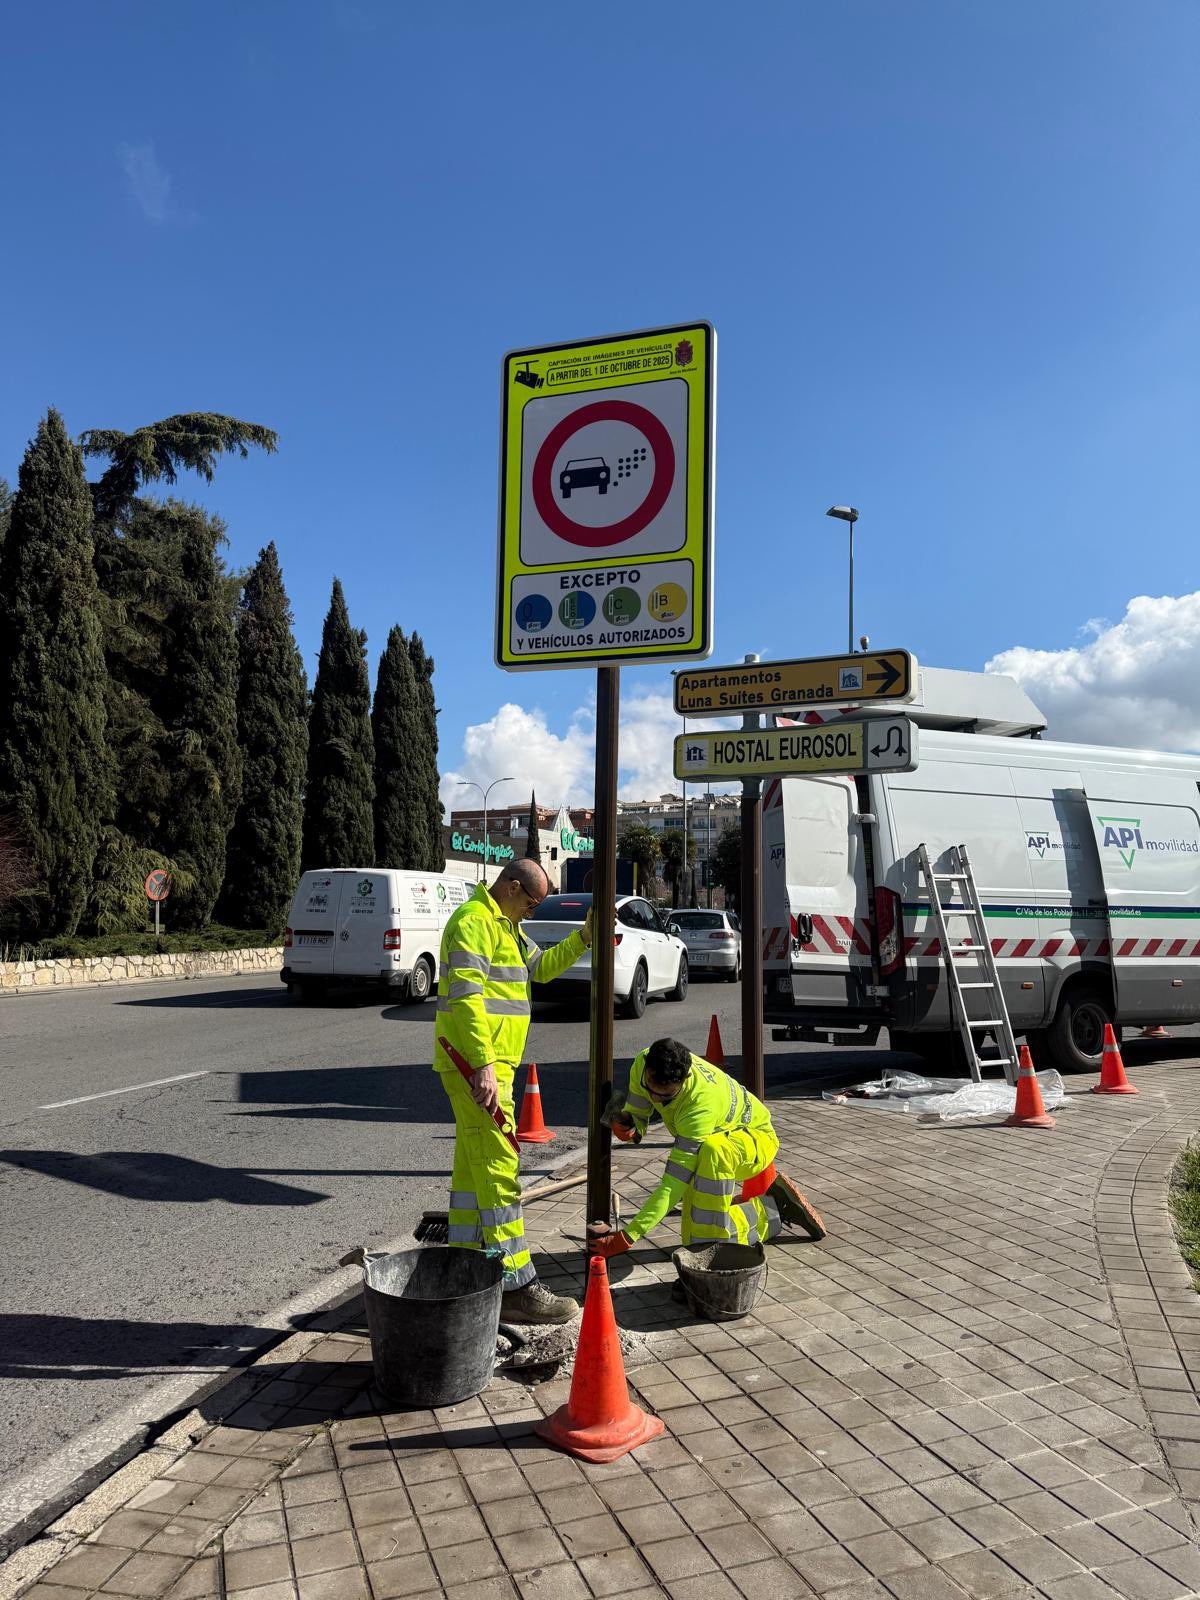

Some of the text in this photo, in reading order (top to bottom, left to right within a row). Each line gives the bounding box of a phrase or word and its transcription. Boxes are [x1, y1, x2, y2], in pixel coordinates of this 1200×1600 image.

[548, 357, 582, 367] CAPTACIÓN
[593, 350, 625, 361] IMÁGENES
[636, 343, 672, 353] VEHÍCULOS
[550, 356, 670, 382] A PARTIR DEL 1 DE OCTUBRE DE 2025
[560, 570, 641, 589] EXCEPTO
[614, 598, 623, 610] C
[659, 594, 668, 606] B
[517, 627, 686, 650] Y VEHÍCULOS AUTORIZADOS
[680, 671, 782, 691] Apartamentos
[680, 685, 834, 709] Luna Suites Granada
[714, 733, 857, 764] HOSTAL EUROSOL
[463, 834, 485, 855] Corte
[1027, 836, 1081, 850] API movilidad
[1103, 826, 1199, 853] API movilidad
[1034, 907, 1042, 916] de
